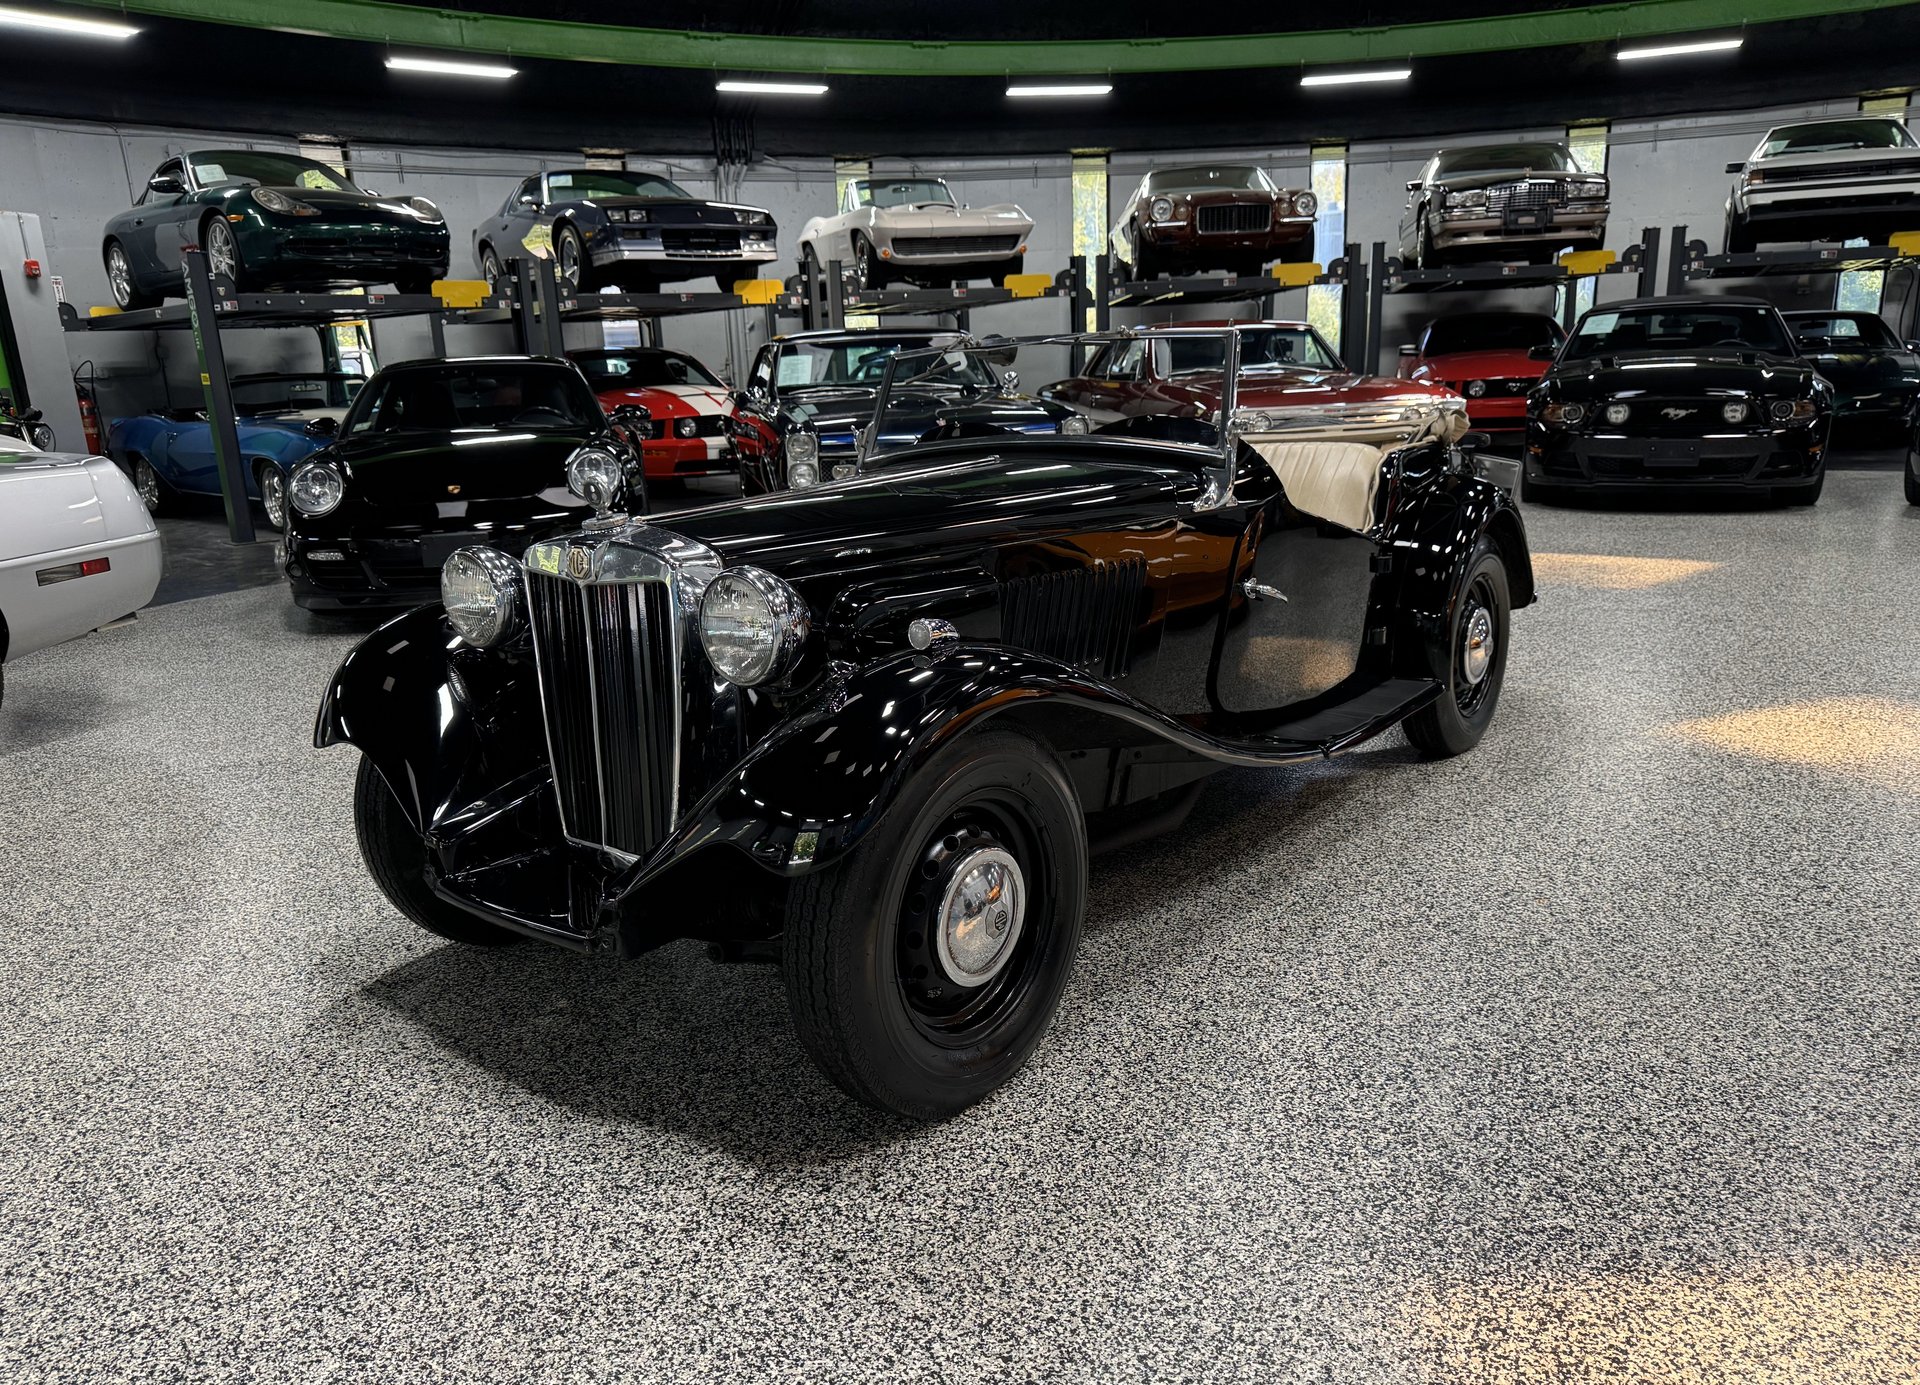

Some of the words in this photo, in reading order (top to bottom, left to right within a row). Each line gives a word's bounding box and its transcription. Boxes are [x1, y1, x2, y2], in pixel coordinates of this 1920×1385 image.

[181, 260, 199, 329] AMGO
[568, 549, 586, 577] MG
[995, 910, 1007, 931] MG
